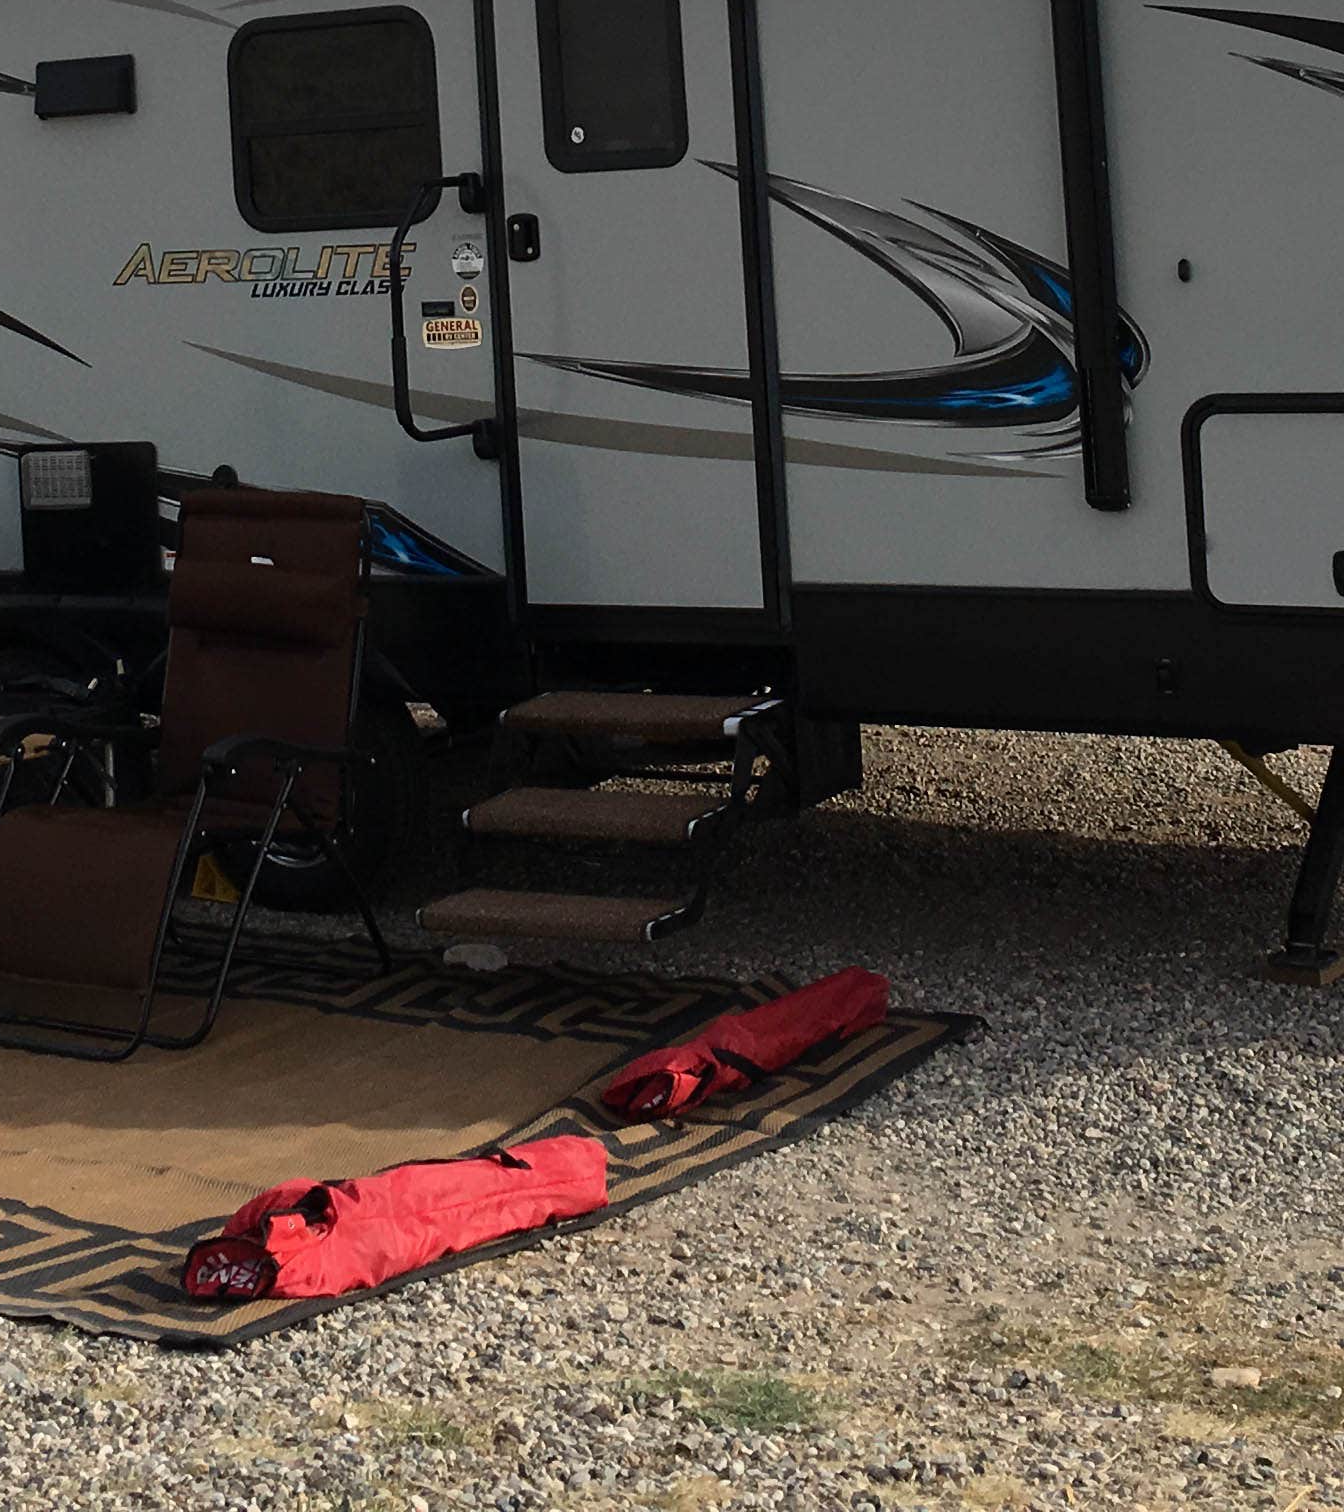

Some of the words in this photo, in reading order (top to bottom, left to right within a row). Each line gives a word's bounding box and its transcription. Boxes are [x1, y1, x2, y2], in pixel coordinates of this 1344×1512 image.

[112, 243, 417, 285] AEROLITE
[251, 281, 332, 298] LUXURY
[426, 320, 478, 332] GENERAL
